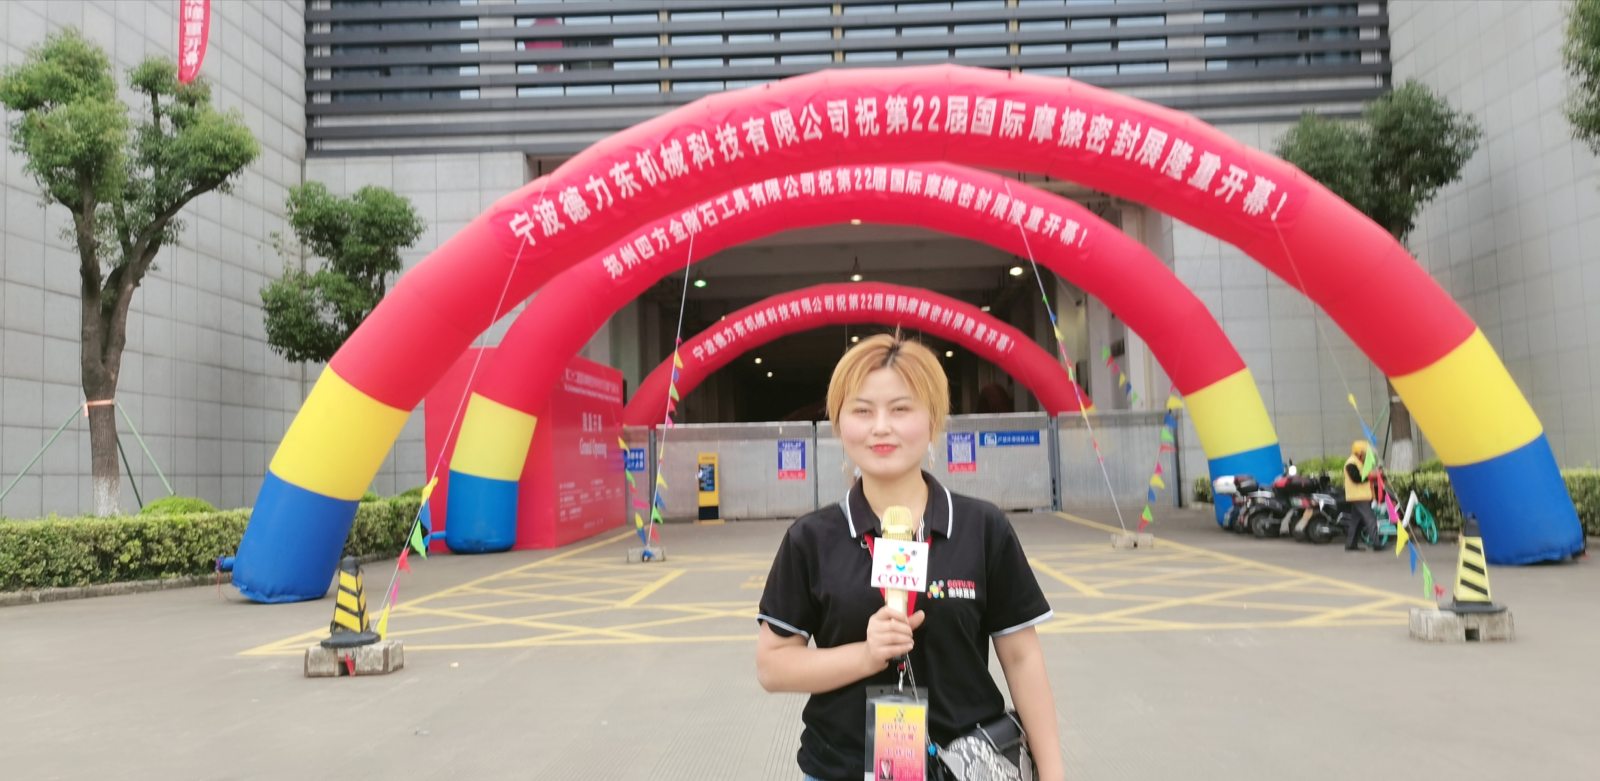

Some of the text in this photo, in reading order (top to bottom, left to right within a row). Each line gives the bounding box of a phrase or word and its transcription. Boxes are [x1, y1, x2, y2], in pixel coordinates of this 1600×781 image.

[508, 94, 1288, 247] 宁波德力东机械科技有限公司祝第22届国际摩擦密封展隆重开幕!
[877, 573, 920, 587] COTV
